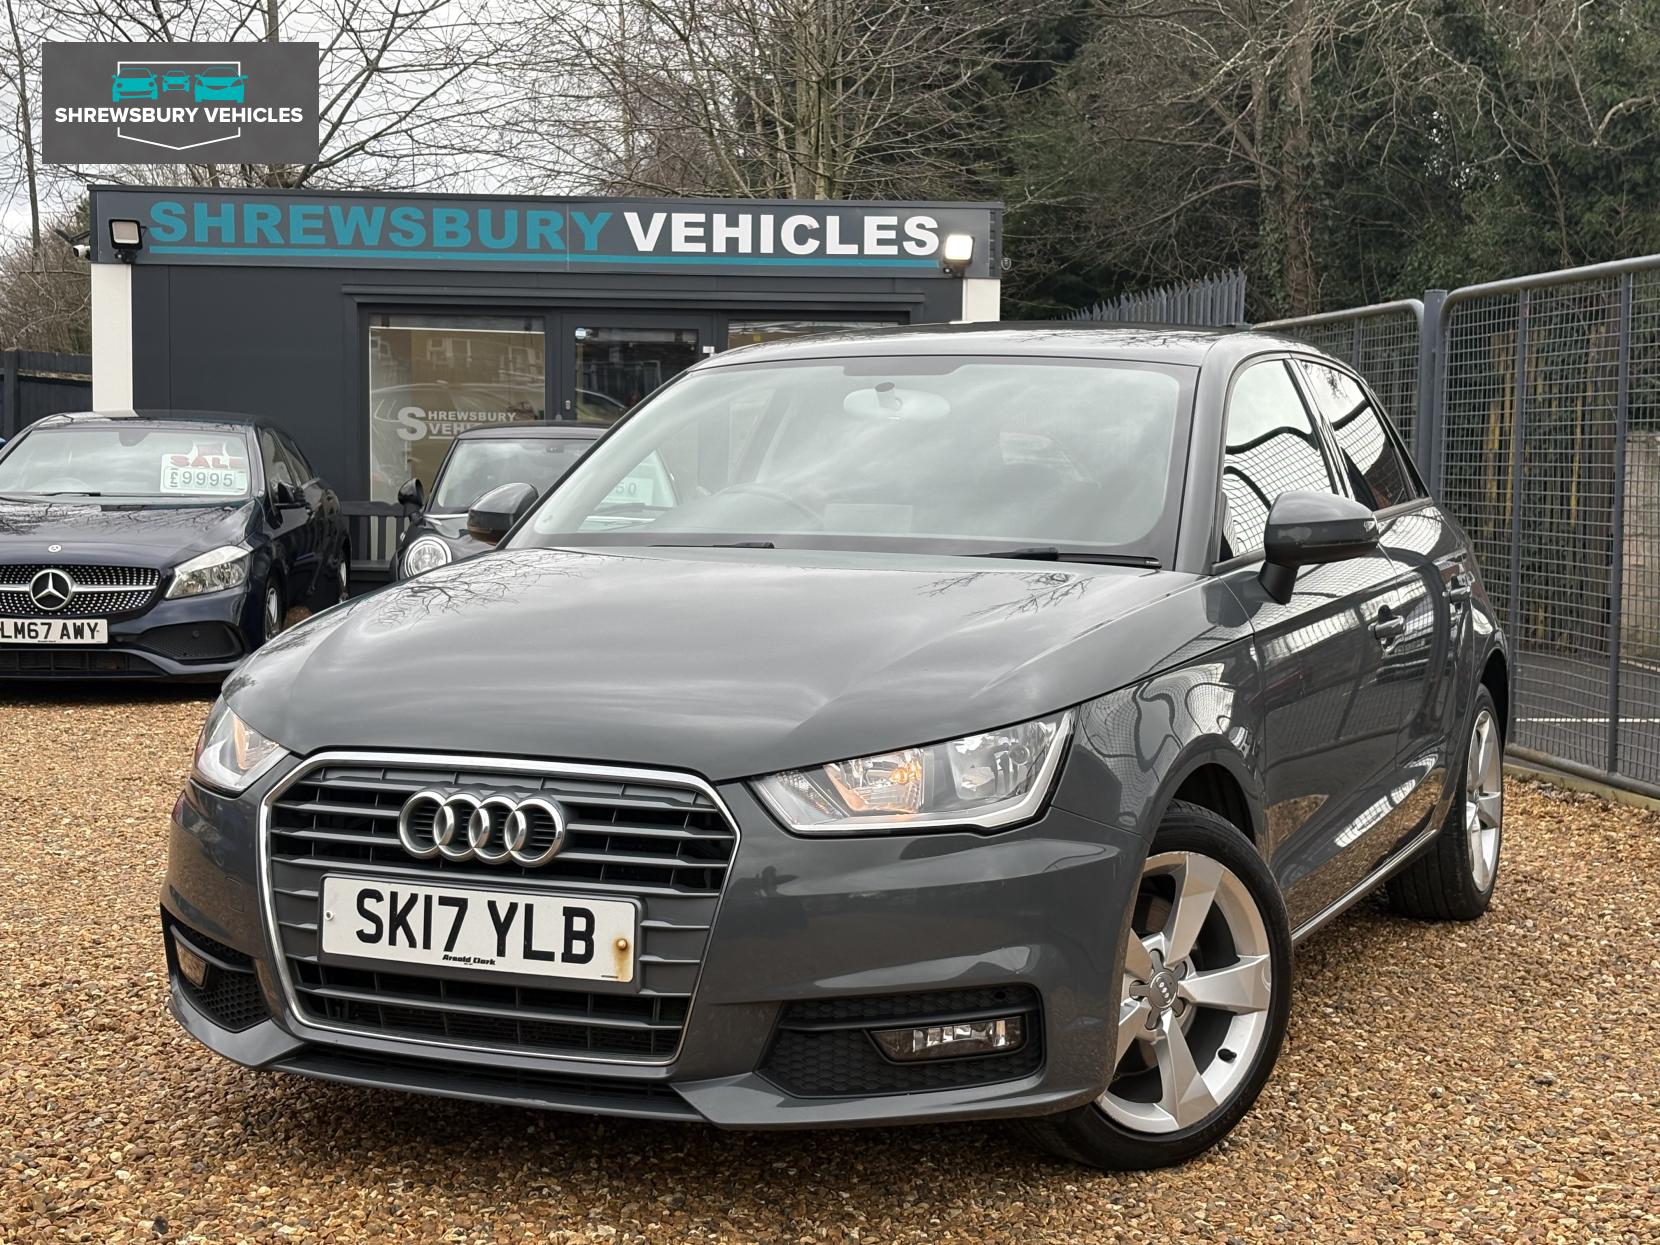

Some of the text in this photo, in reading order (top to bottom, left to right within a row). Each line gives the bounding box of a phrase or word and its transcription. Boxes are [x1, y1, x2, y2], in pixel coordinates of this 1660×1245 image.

[149, 200, 940, 256] SHREWSBURY VEHICLES
[396, 406, 516, 440] SHREWSBURY
[170, 467, 233, 488] £9995
[1, 621, 98, 639] LM67 AWY
[356, 888, 595, 964] SK17 YLB
[442, 953, 472, 963] Arnold
